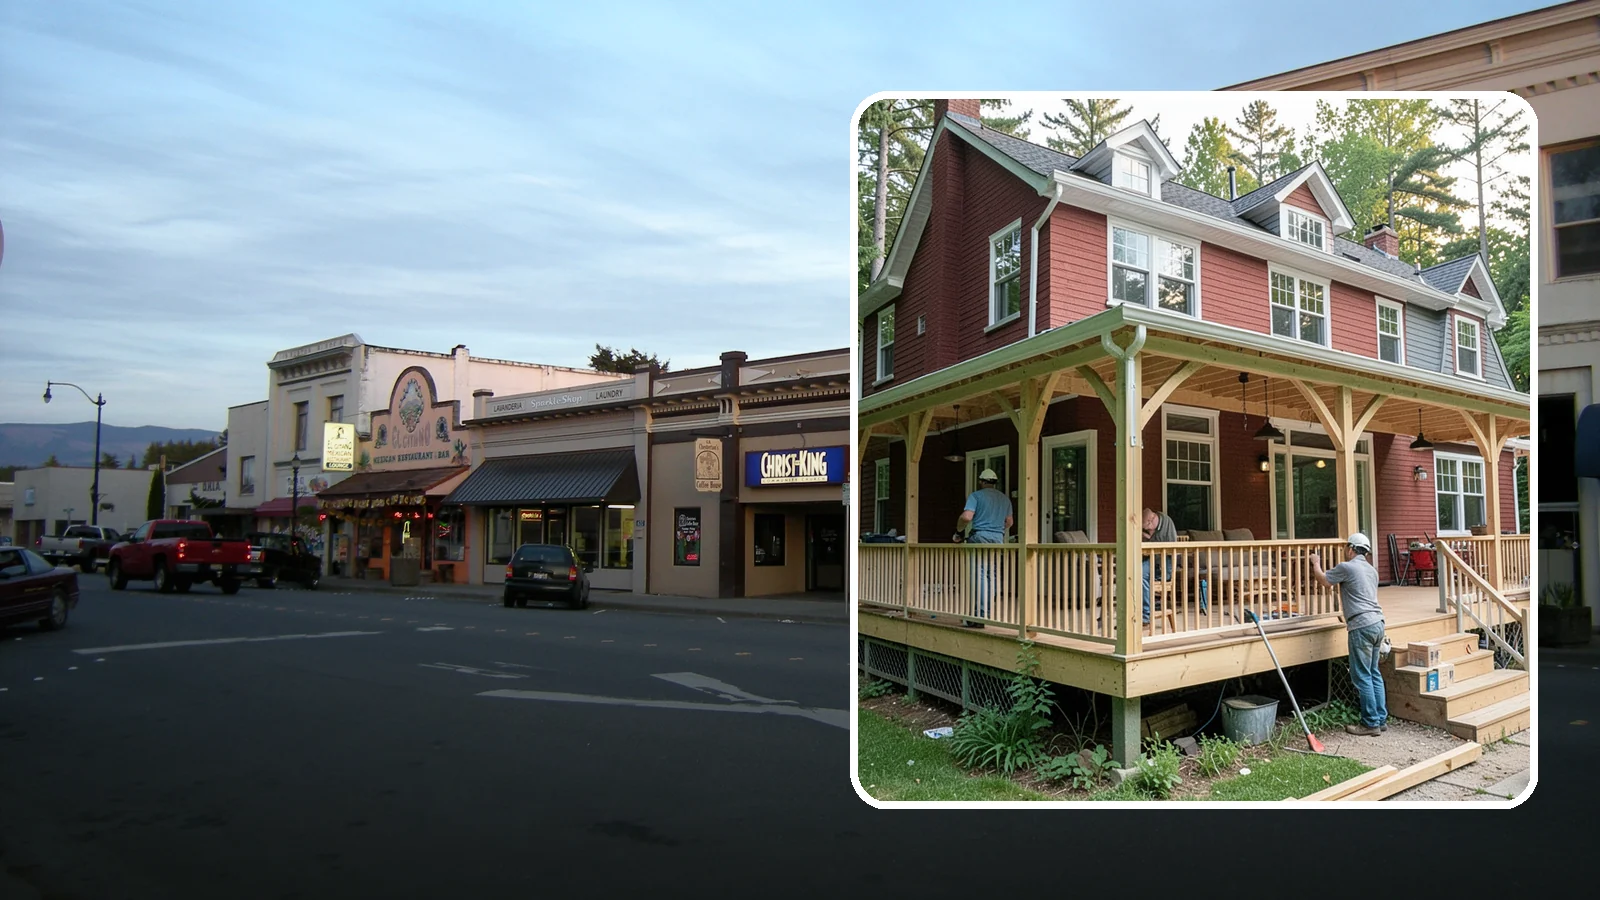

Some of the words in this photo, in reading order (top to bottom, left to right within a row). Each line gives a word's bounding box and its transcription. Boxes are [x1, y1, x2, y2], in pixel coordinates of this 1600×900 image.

[595, 389, 623, 399] LAUNDRY
[493, 402, 522, 412] LAVANDERIA
[531, 398, 560, 409] Sparkle
[561, 394, 583, 405] Shop
[373, 454, 396, 464] MEXICAN
[397, 451, 433, 462] RESTAURANT
[437, 450, 450, 459] BAR
[761, 452, 797, 478] CHRIST
[799, 450, 828, 476] KING
